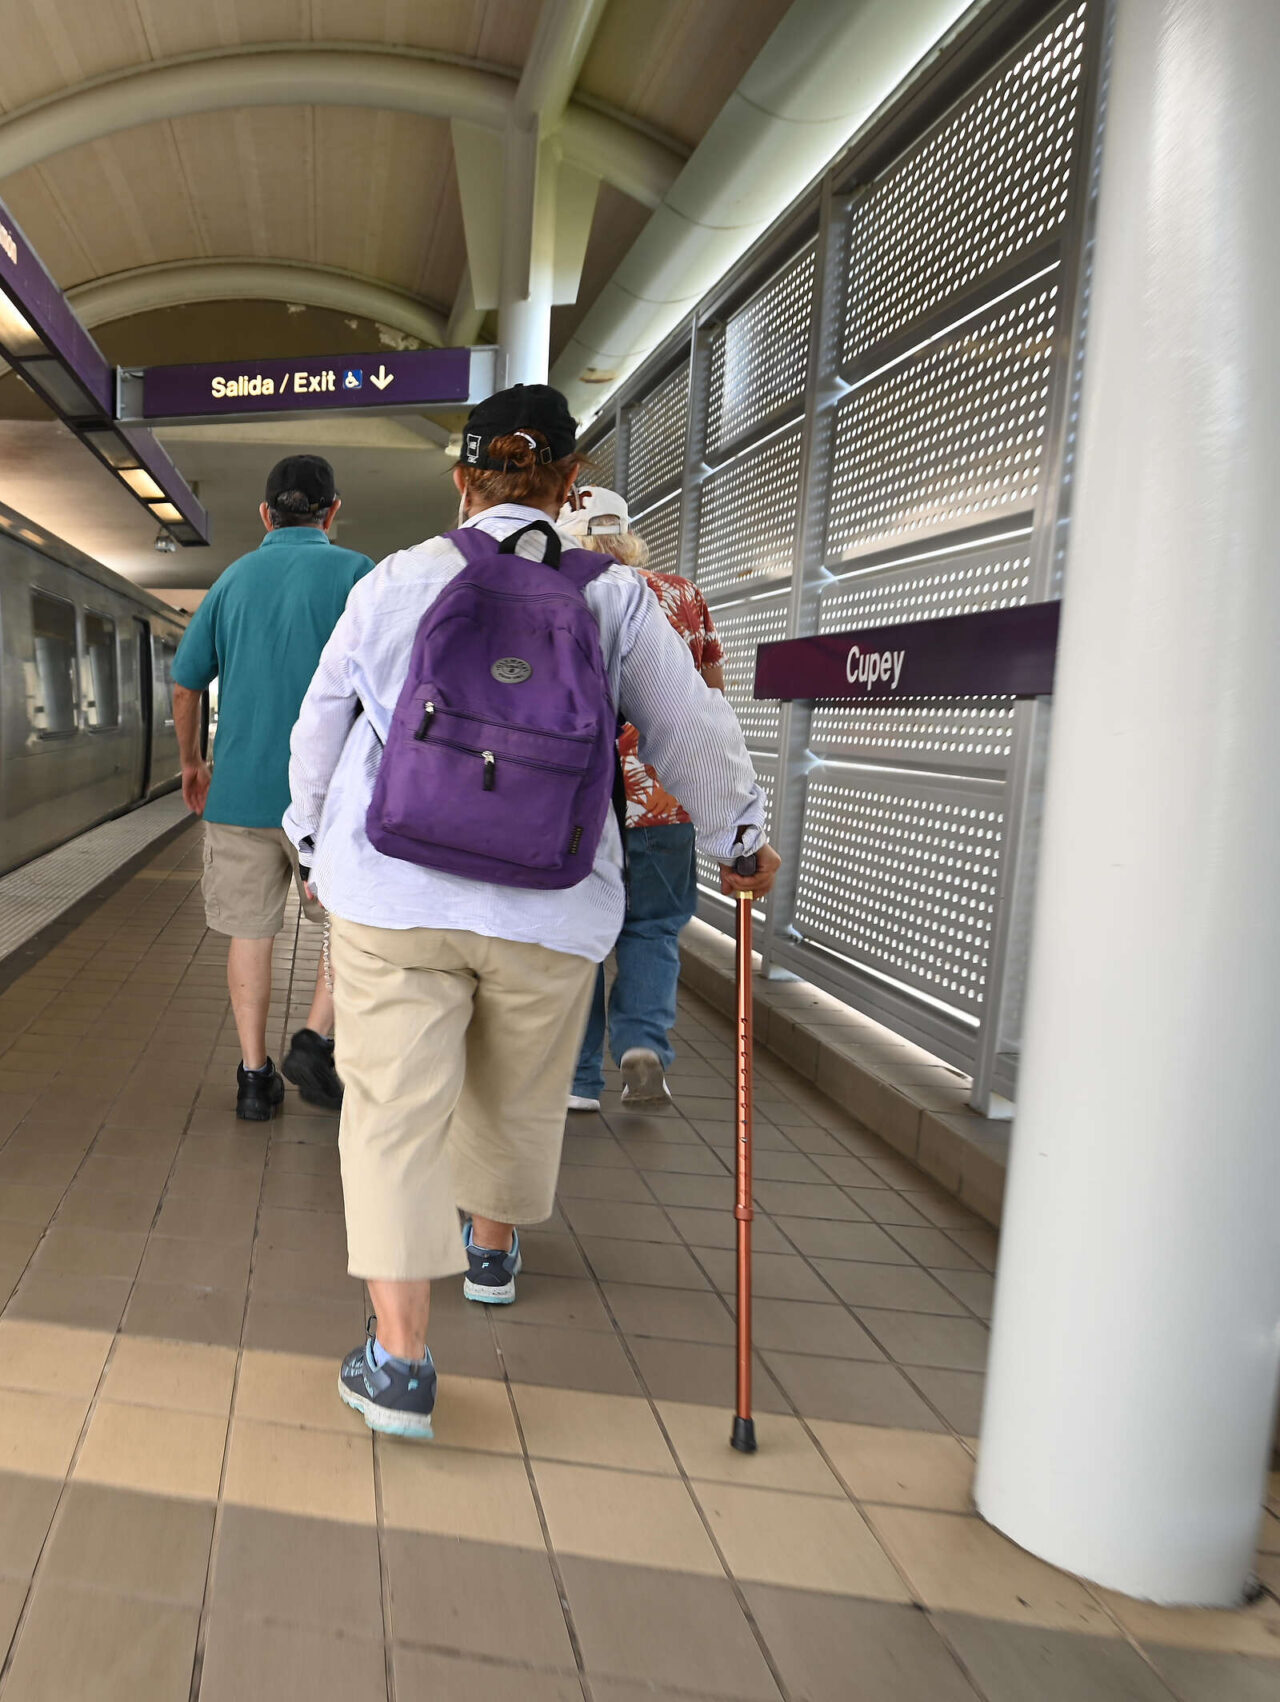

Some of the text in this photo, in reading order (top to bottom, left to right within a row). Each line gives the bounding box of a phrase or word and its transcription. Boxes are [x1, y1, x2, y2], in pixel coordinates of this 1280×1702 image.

[211, 370, 336, 398] Salida / Exit
[846, 645, 905, 690] Cupey
